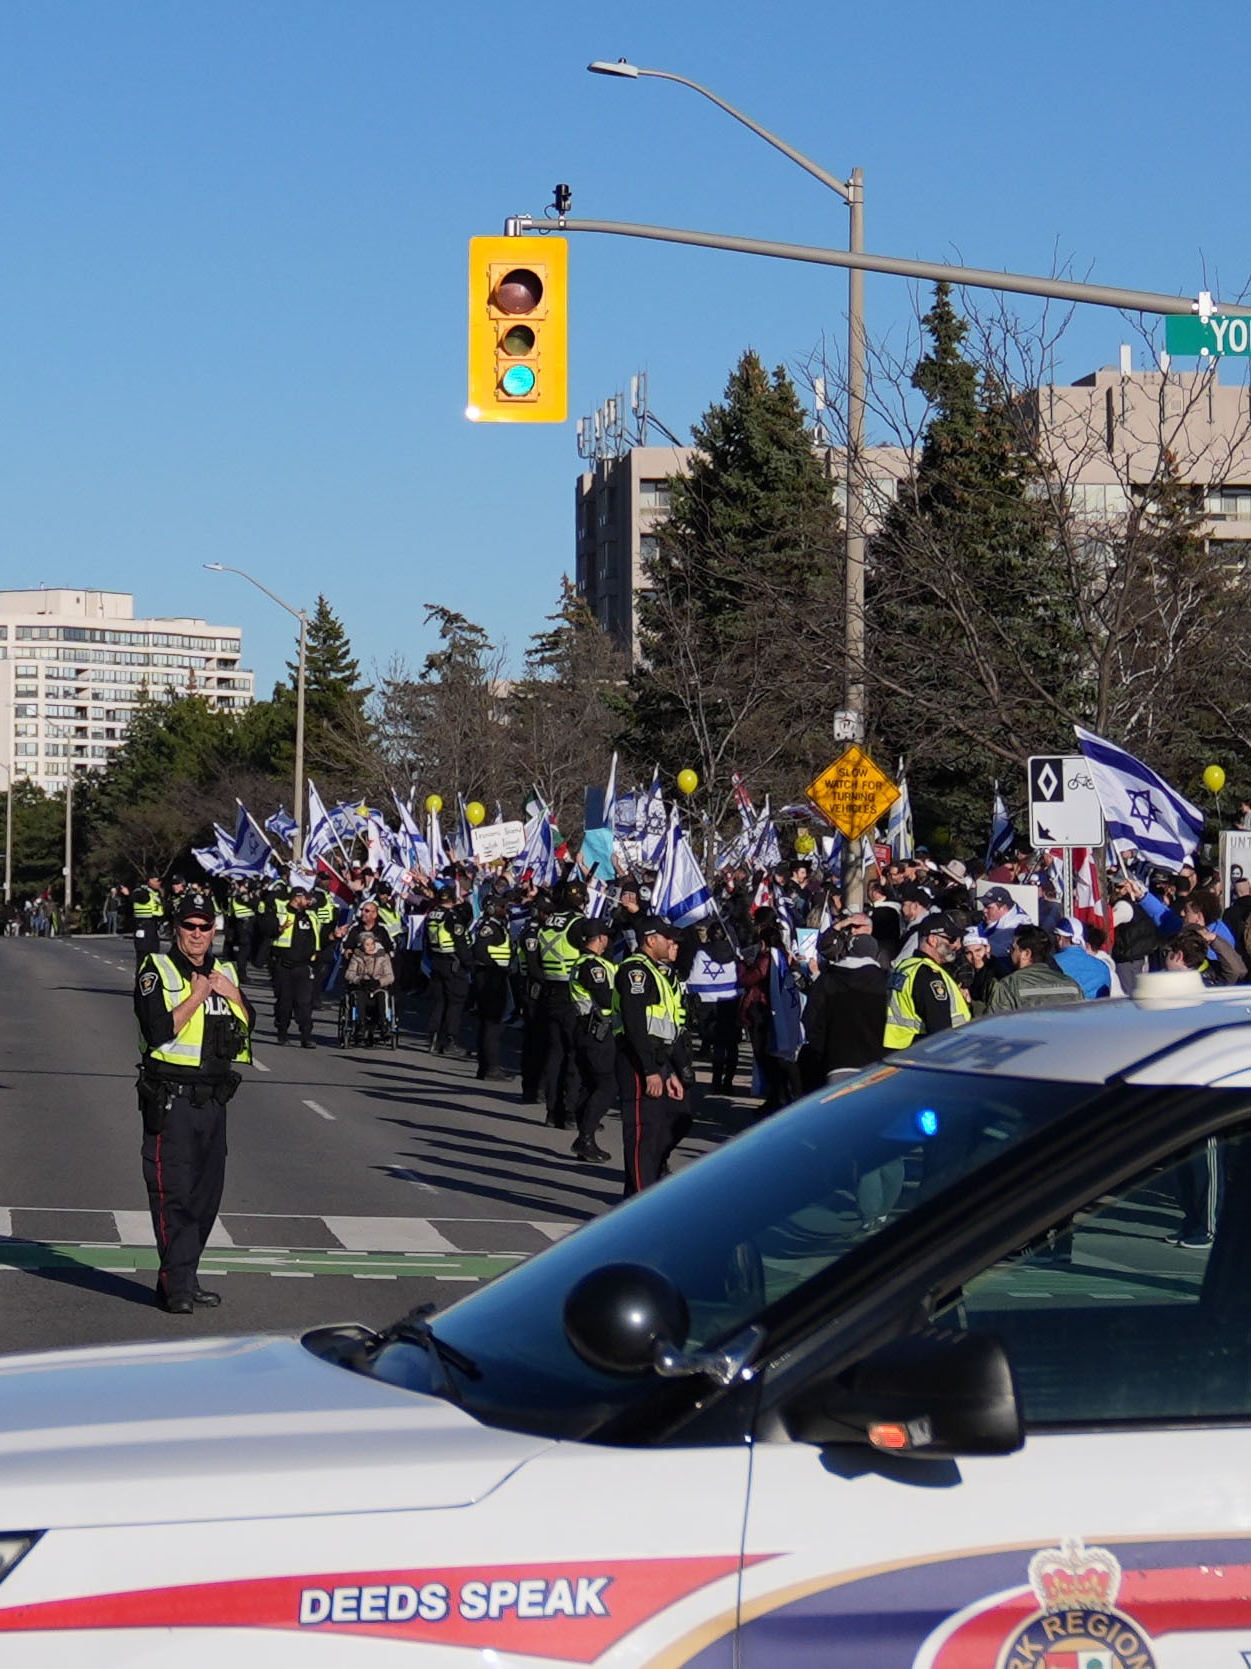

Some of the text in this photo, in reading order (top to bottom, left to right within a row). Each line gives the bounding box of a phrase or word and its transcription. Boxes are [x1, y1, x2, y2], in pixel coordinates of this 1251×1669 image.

[1210, 319, 1251, 353] YO
[838, 767, 868, 778] SLOW
[825, 780, 882, 790] WATCH FOR
[832, 791, 875, 803] TURNING
[829, 804, 877, 814] VEHICLES
[299, 1576, 614, 1625] DEEDS SPEAK
